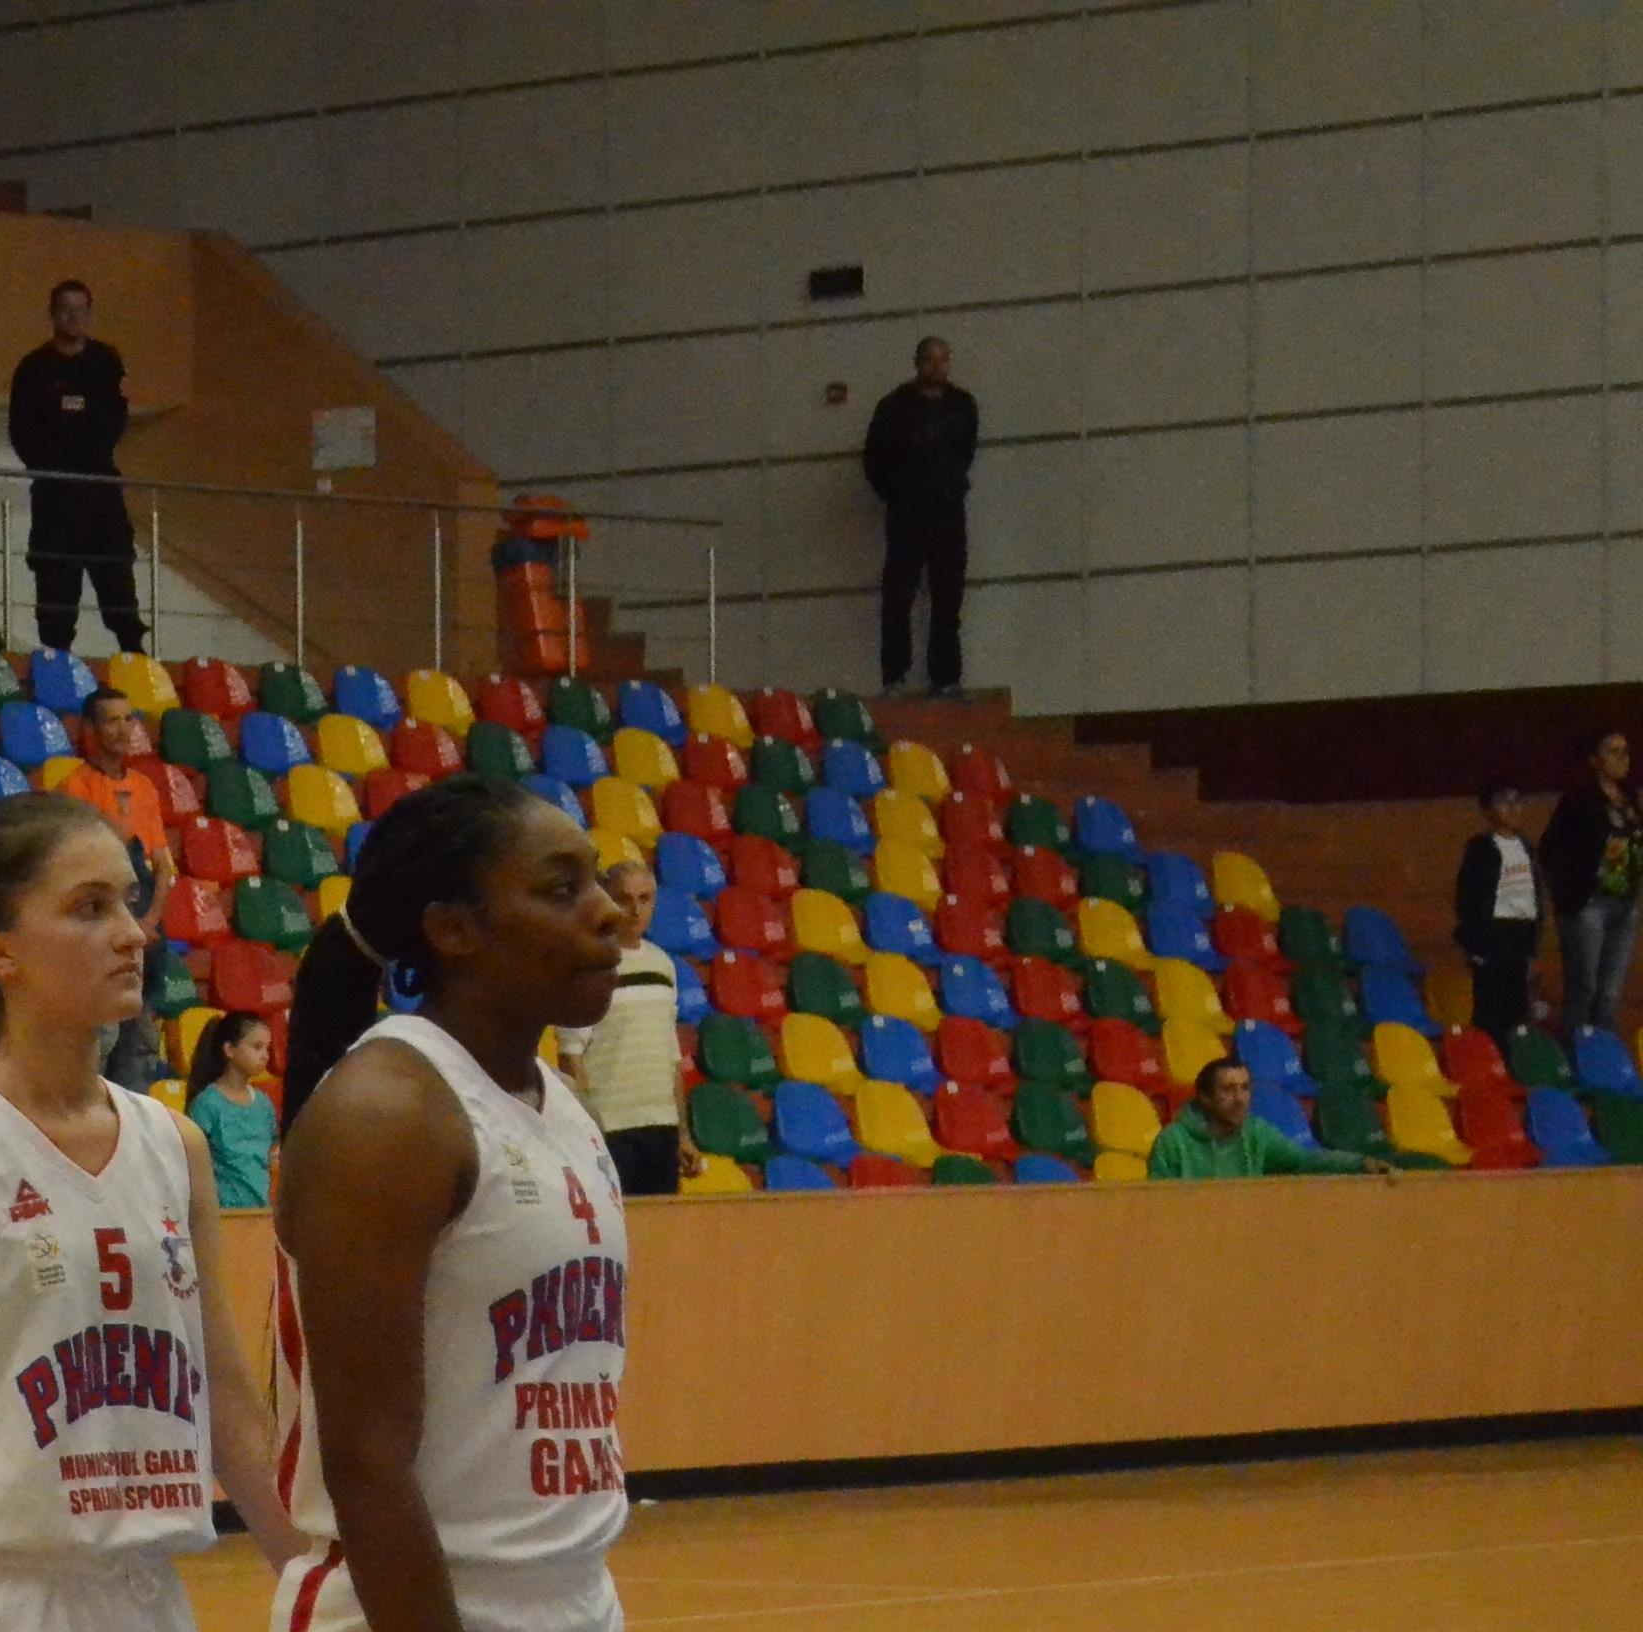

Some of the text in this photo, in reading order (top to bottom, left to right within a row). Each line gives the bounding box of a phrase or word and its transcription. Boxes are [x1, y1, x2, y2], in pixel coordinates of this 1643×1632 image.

[562, 1167, 601, 1245] 4
[93, 1227, 134, 1312] 5
[144, 1449, 199, 1476] GALA
